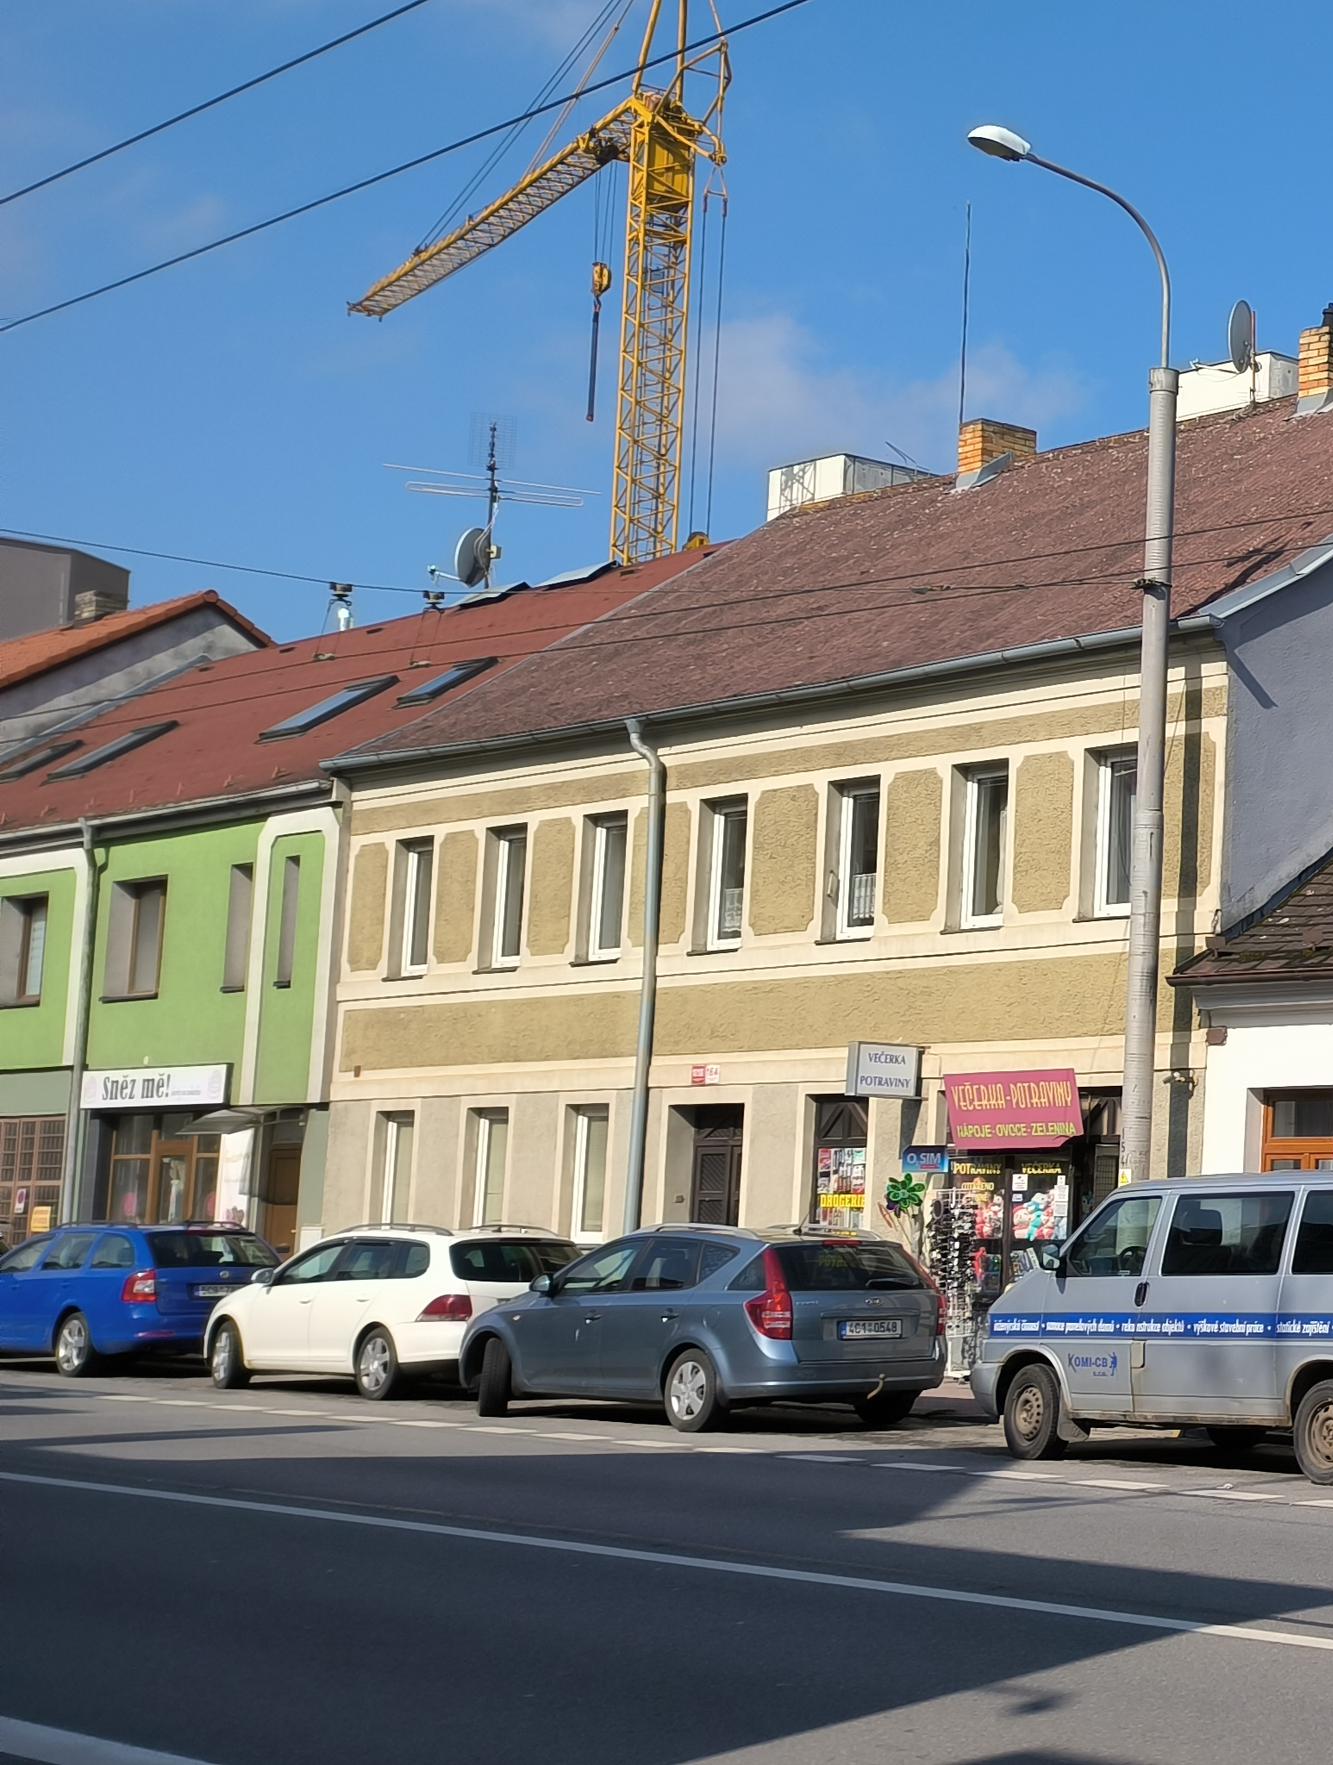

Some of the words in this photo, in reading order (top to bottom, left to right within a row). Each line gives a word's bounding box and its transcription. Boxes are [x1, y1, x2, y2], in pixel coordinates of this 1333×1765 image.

[868, 1051, 906, 1065] VEČERKA
[102, 1074, 136, 1101] Sněz
[141, 1072, 171, 1099] mě!
[860, 1075, 912, 1089] POTRAVINY
[919, 1152, 942, 1164] SIM
[1068, 1353, 1108, 1373] KOMI-CB
